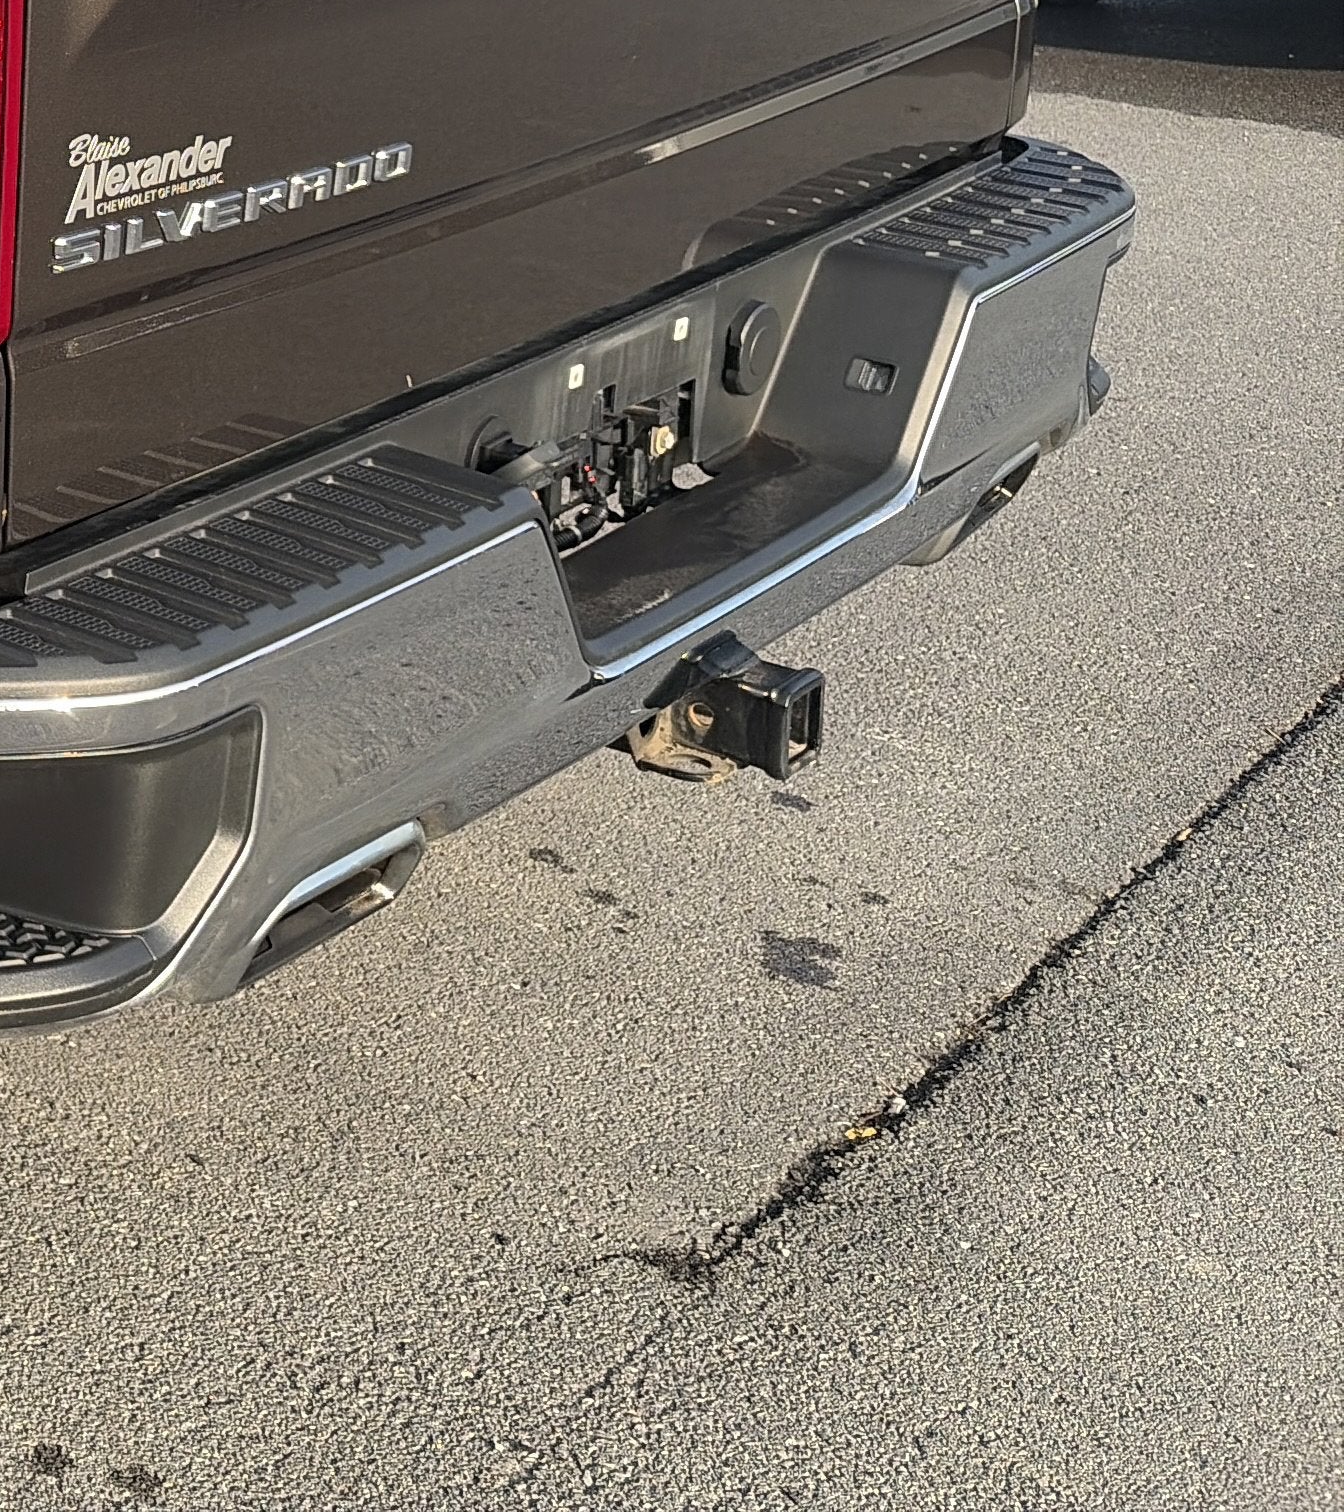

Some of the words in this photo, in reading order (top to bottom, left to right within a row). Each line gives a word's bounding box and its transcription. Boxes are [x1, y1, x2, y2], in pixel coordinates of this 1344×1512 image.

[64, 134, 233, 225] Alexander
[68, 133, 131, 169] Blaise
[51, 141, 413, 274] SILVERADO
[96, 189, 157, 216] CHEVROLET
[157, 185, 172, 199] OF
